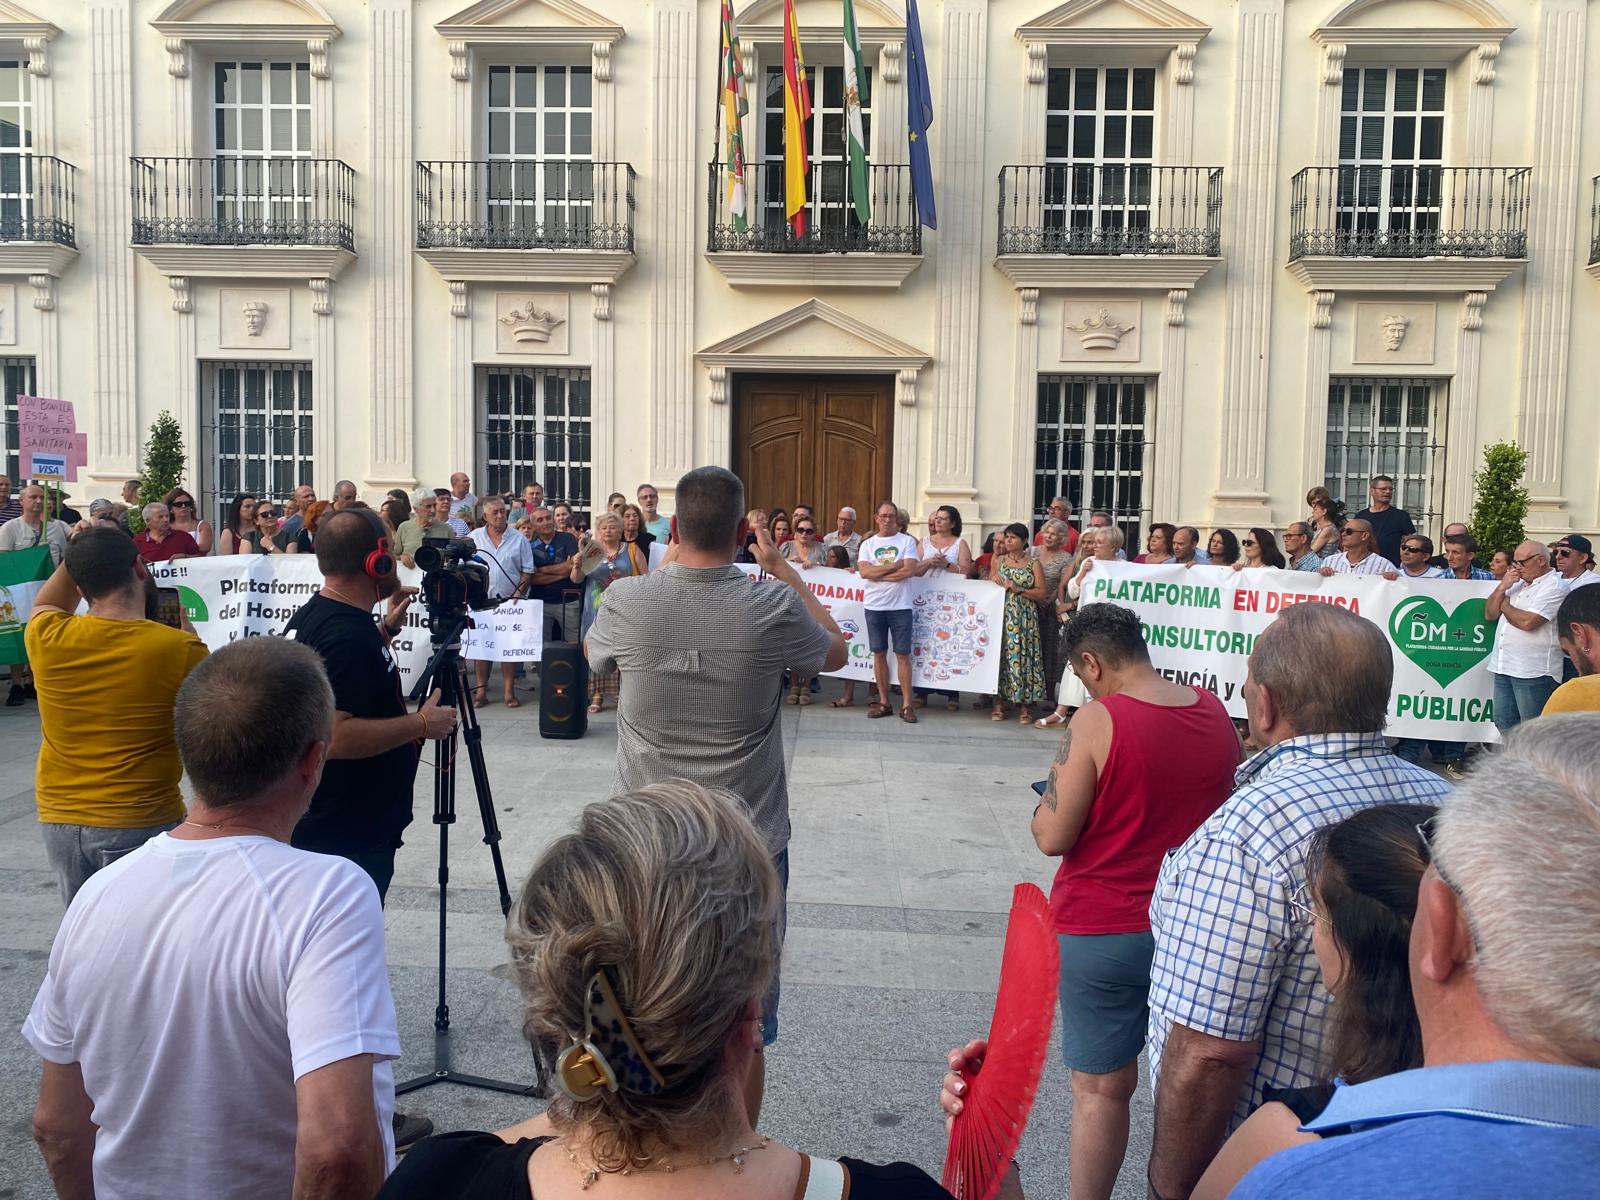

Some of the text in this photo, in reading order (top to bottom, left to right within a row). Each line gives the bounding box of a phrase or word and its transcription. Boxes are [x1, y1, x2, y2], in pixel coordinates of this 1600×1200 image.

[25, 411, 72, 424] ESTA ES
[22, 423, 34, 433] TU
[38, 465, 59, 474] VISA
[220, 578, 321, 595] Plataforma
[1095, 579, 1221, 609] PLATAFORMA
[1233, 589, 1259, 612] EN
[219, 602, 241, 620] del
[512, 623, 522, 631] SE
[1472, 624, 1485, 644] S
[1142, 623, 1261, 655] ONSULTORI
[502, 648, 535, 656] DEFIENDE
[1224, 682, 1235, 701] y
[1396, 689, 1495, 723] PÚBLICA
